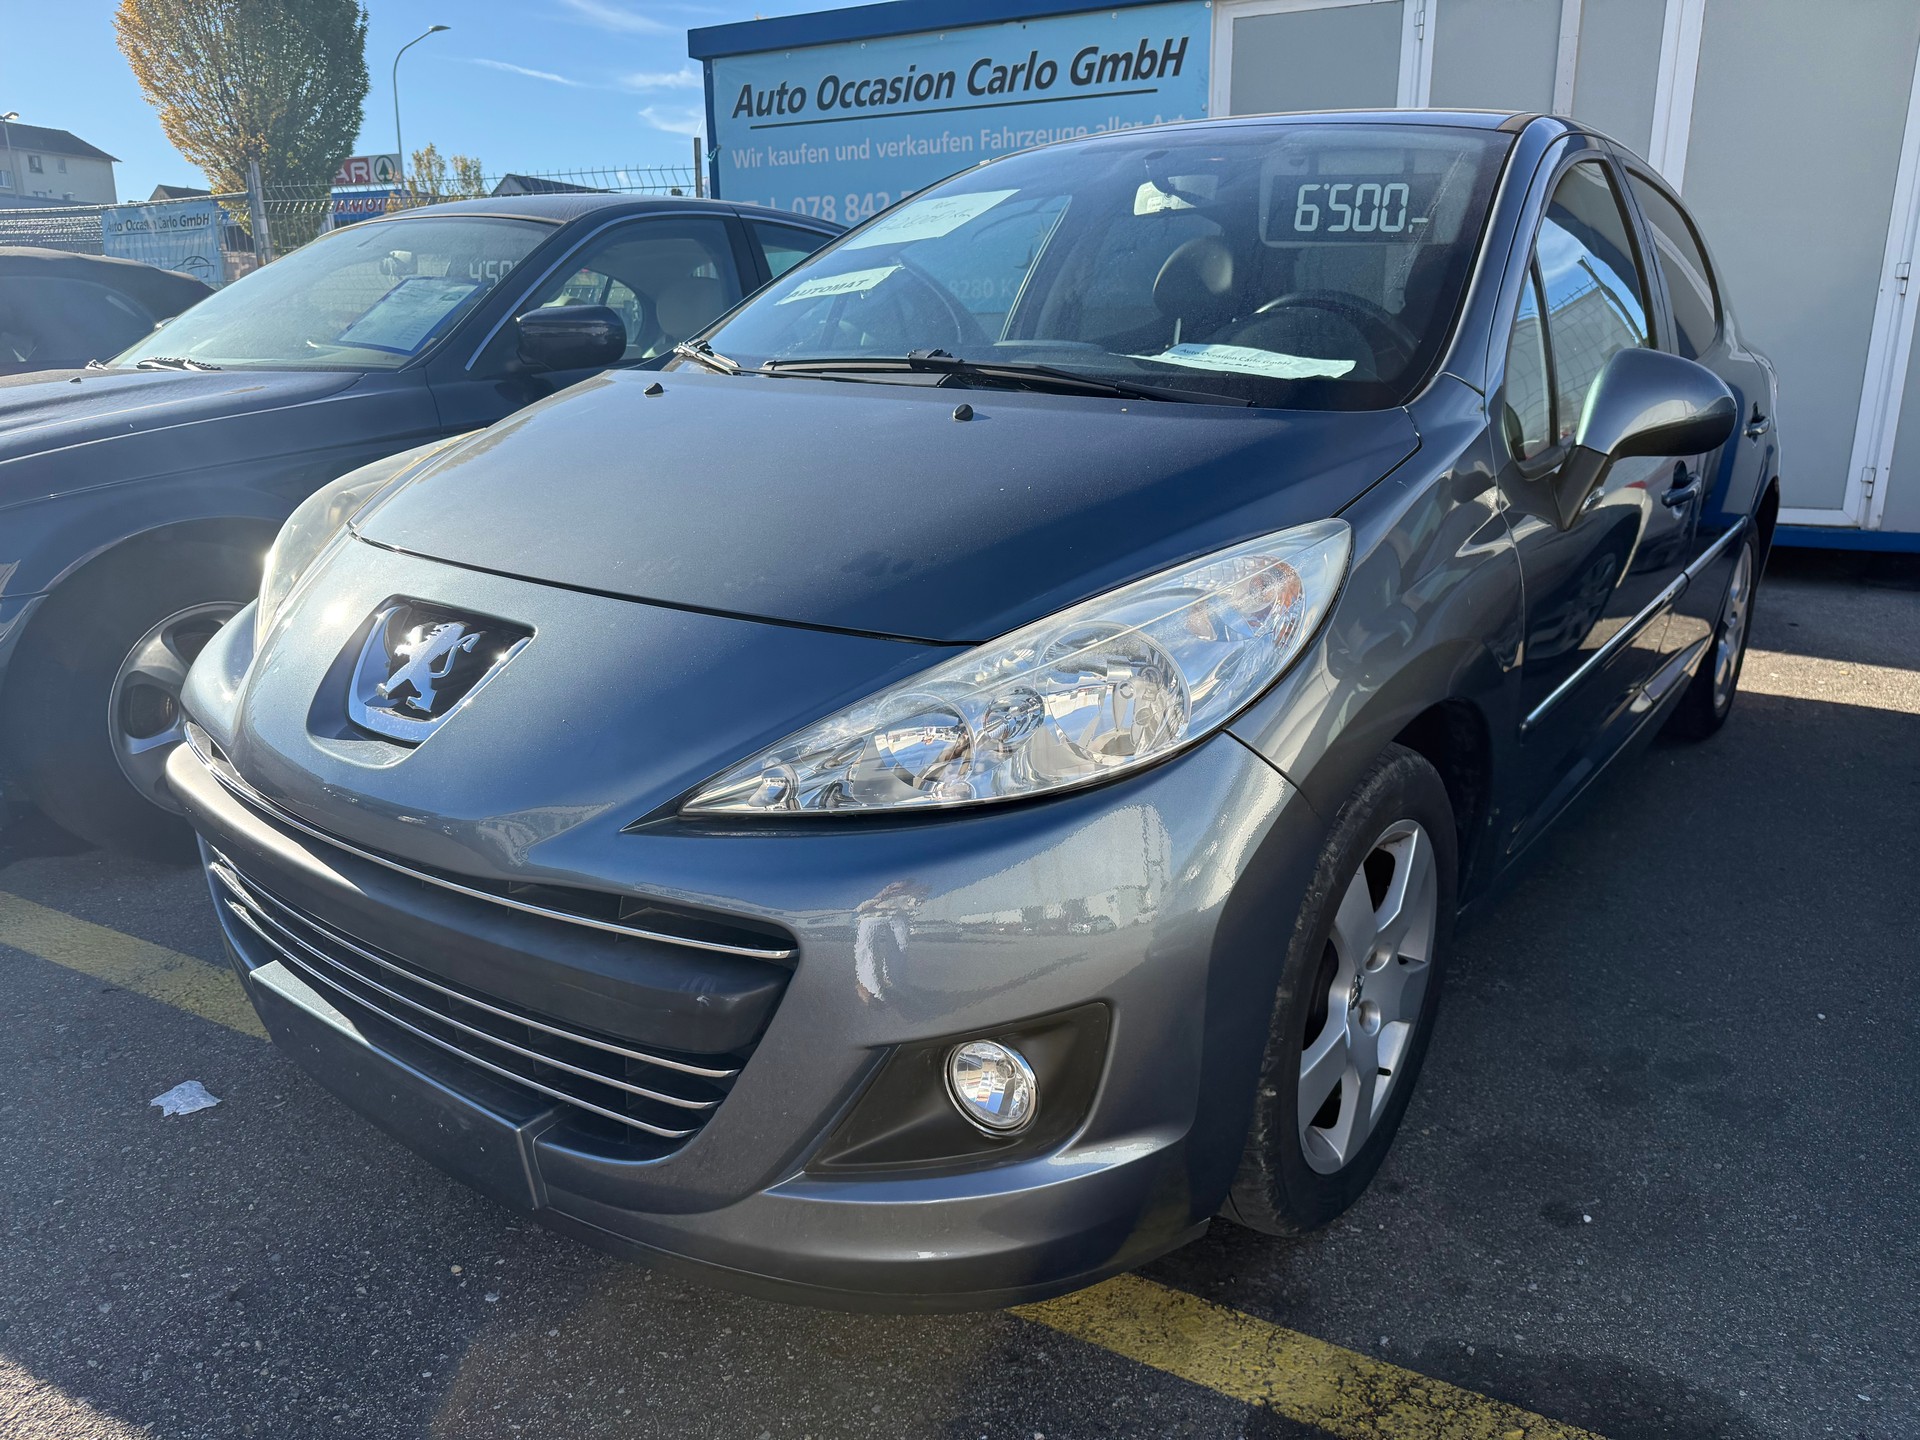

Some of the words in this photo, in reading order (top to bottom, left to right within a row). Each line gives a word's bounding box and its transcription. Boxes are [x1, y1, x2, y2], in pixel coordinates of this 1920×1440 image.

[731, 84, 807, 119] Auto
[816, 65, 955, 111] Occasion
[966, 50, 1058, 96] Carlo
[1070, 37, 1190, 86] GmbH
[732, 149, 765, 170] Wir
[768, 141, 829, 168] kaufen
[835, 136, 871, 161] und
[876, 133, 973, 159] verkaufen
[333, 161, 369, 183] AR
[792, 196, 837, 223] 078
[844, 192, 890, 222] 842
[125, 218, 158, 232] Occasn
[179, 212, 211, 228] GmbH
[469, 260, 520, 284] 4'50
[786, 276, 871, 298] AUTOMAT
